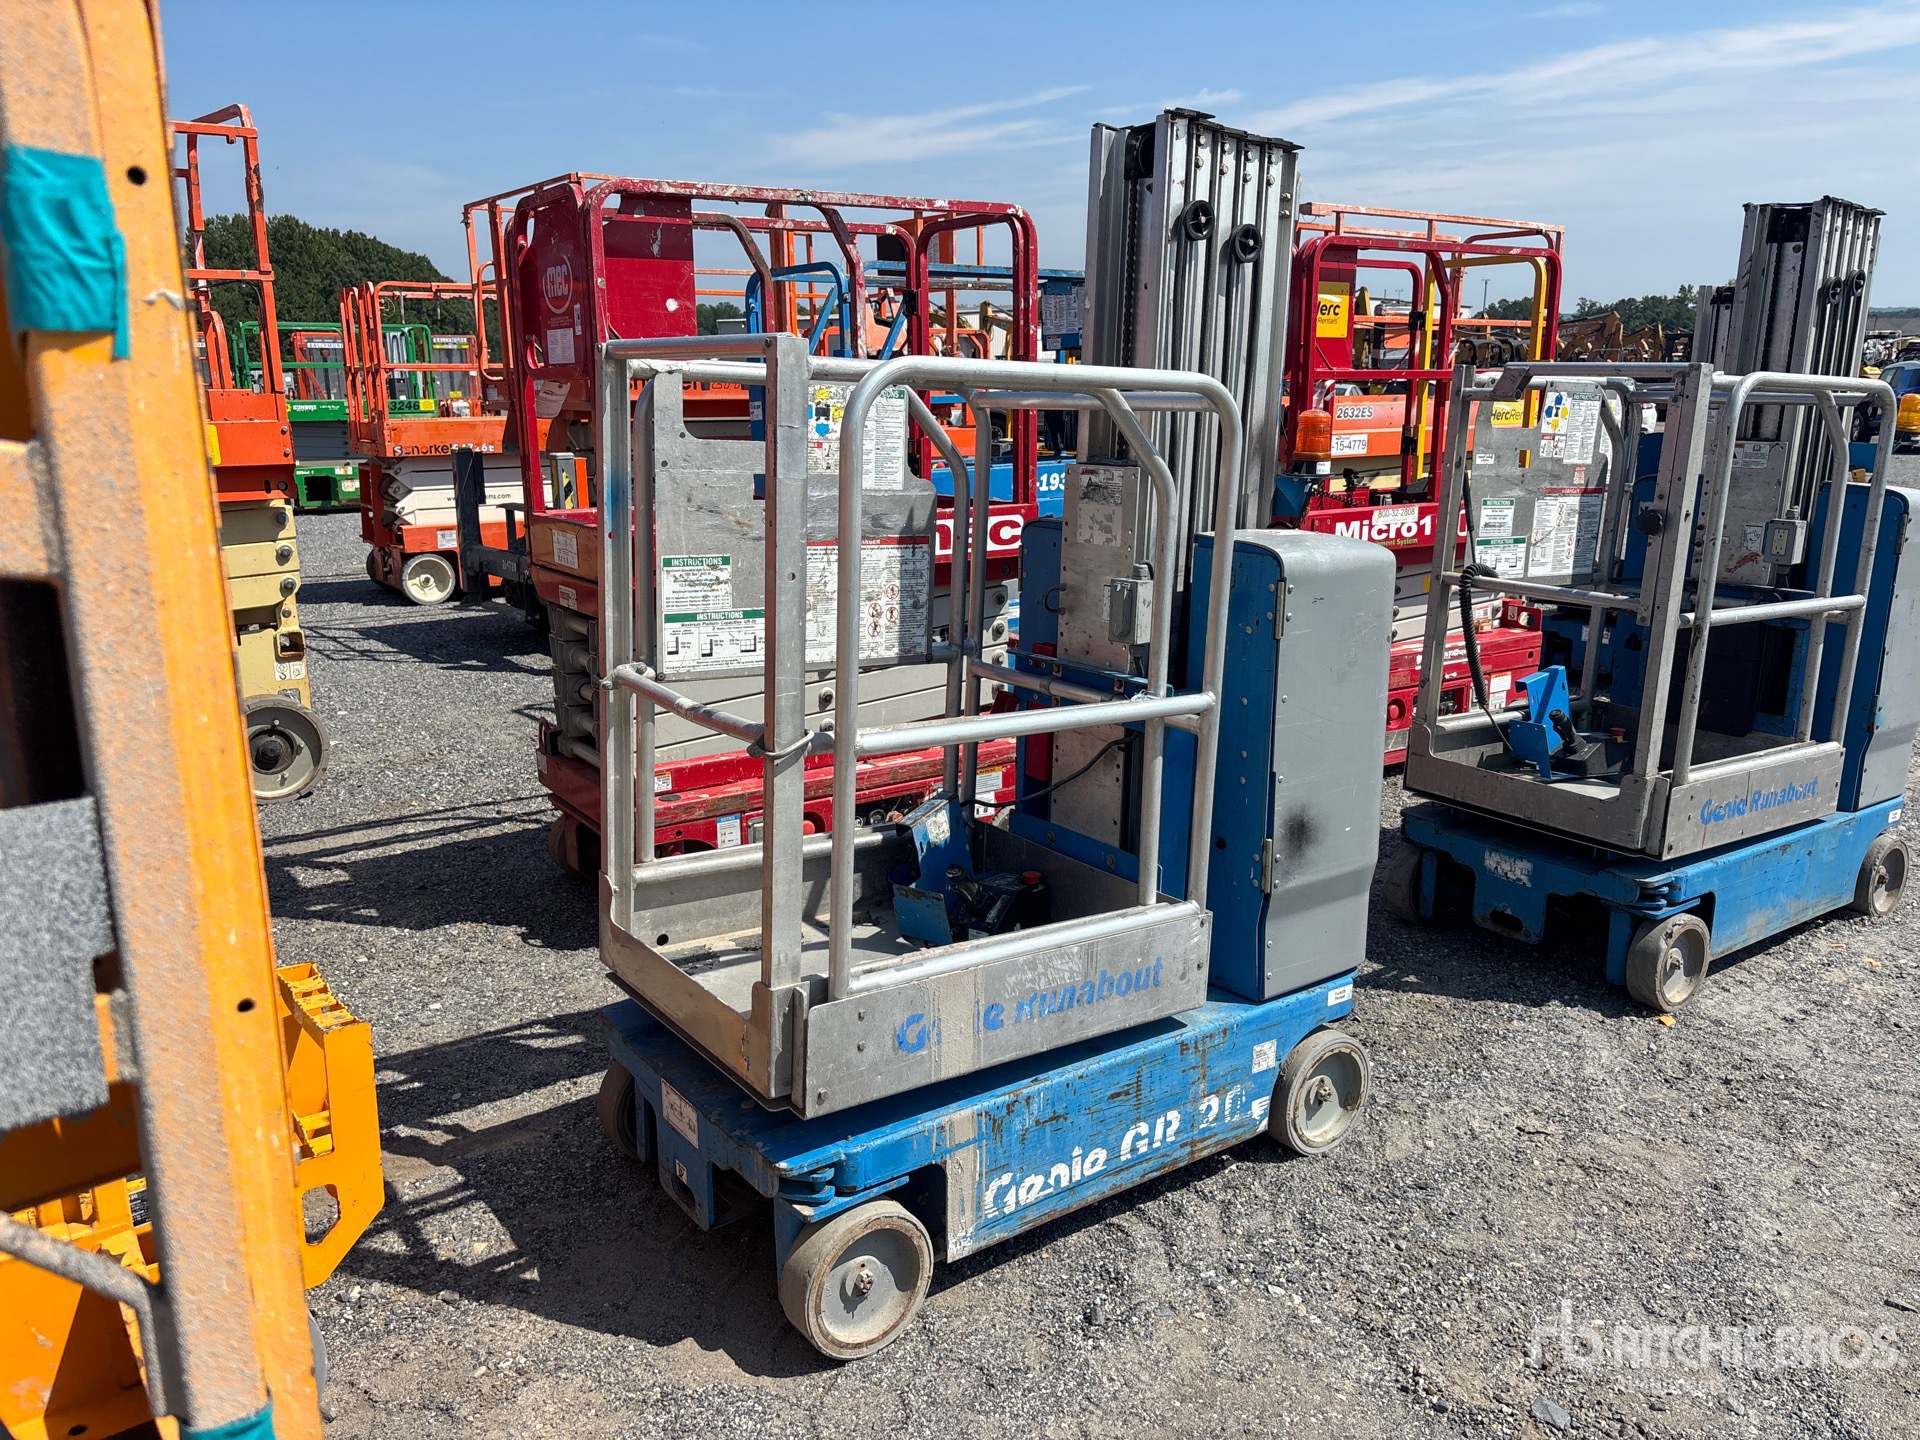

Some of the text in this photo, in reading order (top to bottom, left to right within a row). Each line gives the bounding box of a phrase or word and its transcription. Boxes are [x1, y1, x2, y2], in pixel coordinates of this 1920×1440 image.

[547, 265, 569, 297] mec
[1559, 327, 1580, 336] ASE
[1336, 406, 1373, 419] 2632ES
[671, 558, 723, 567] INSTRUCTIONS
[697, 612, 744, 621] INSTRUCTIONS
[1749, 775, 1819, 813] Runabout
[983, 1145, 1108, 1219] Genie
